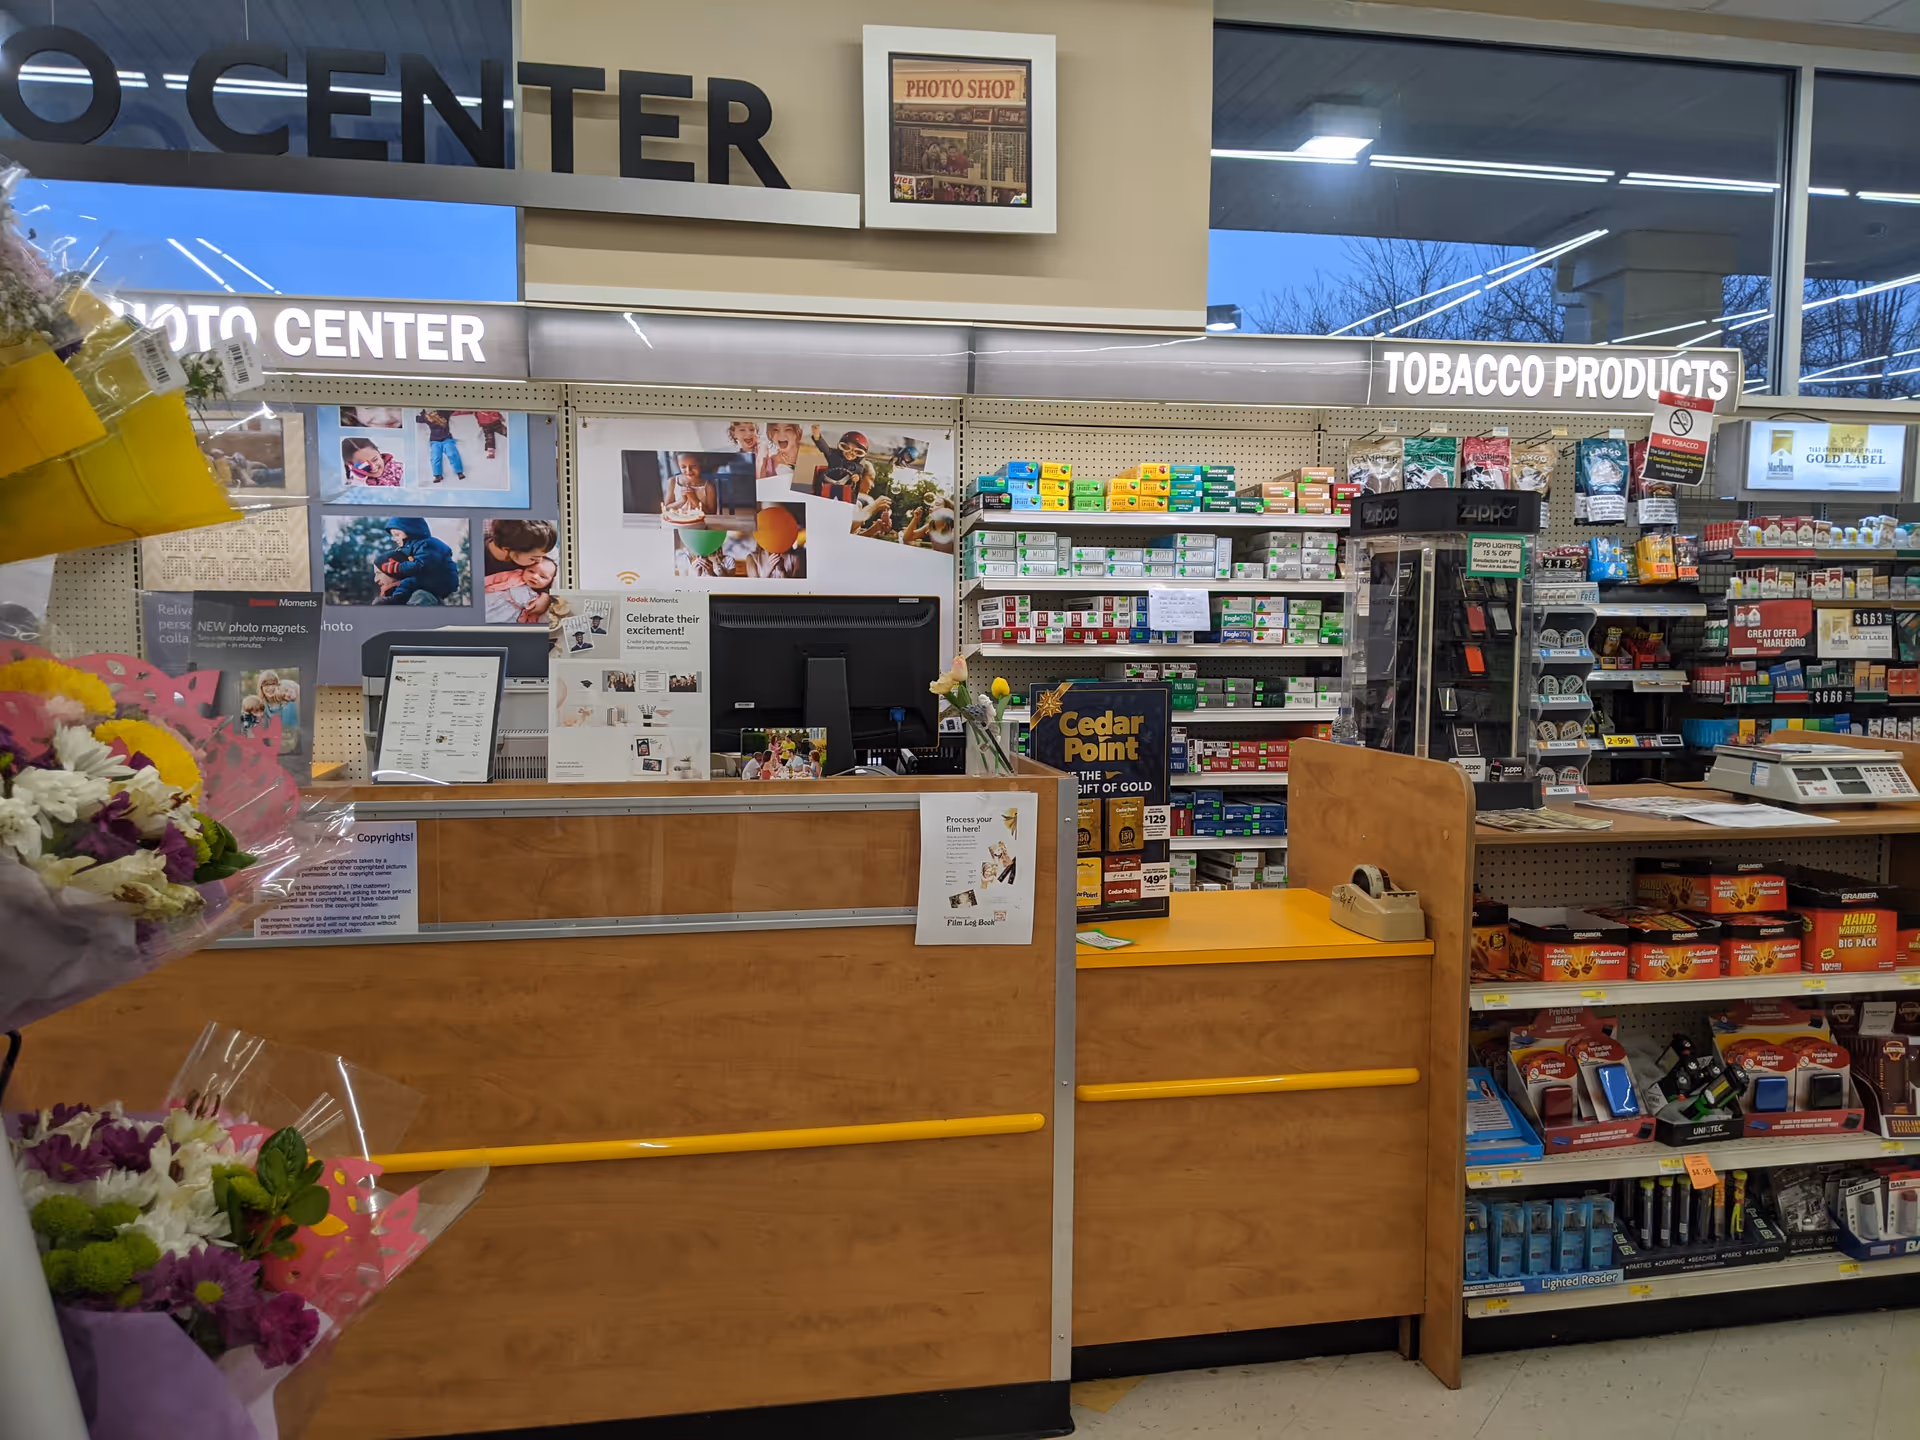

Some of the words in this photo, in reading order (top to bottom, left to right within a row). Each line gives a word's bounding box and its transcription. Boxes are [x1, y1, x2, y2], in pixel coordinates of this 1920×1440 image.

[906, 79, 964, 99] PHOTO
[967, 80, 1015, 99] SHOP
[186, 39, 792, 190] CENTER
[274, 308, 486, 362] CENTER
[1384, 351, 1545, 397] TOBACCO
[1553, 356, 1729, 400] PRODUCTS
[1671, 440, 1699, 449] TOBACCO
[1589, 447, 1622, 457] LARGO
[1672, 458, 1688, 467] Smoking
[1806, 454, 1841, 464] GOLD
[1845, 454, 1886, 465] LABEL
[1768, 458, 1794, 472] Marlboro
[1580, 593, 1596, 601] FREE
[279, 598, 317, 607] Moments
[626, 613, 674, 623] Celebrate
[676, 614, 700, 624] their
[1224, 614, 1240, 622] Eagle
[198, 622, 226, 632] NEW
[229, 622, 259, 634] photo
[261, 623, 309, 635] magnets.
[626, 626, 685, 635] excitement!
[1223, 630, 1240, 638] Eagle
[1747, 629, 1772, 638] GREAT
[1773, 629, 1797, 637] OFFER
[1542, 634, 1559, 643] ROGUE
[1763, 638, 1806, 647] MARLBORO
[1058, 711, 1145, 737] Cedar
[1064, 736, 1139, 762] Point
[1080, 771, 1101, 780] THE
[1077, 783, 1100, 794] GIFT
[1102, 783, 1118, 793] OF
[1120, 782, 1152, 793] GOLD
[946, 816, 975, 824] Process
[976, 816, 992, 825] your
[1145, 814, 1166, 824] $129
[946, 825, 961, 833] film
[962, 825, 981, 833] here!
[357, 832, 414, 844] Copyrights!
[1120, 832, 1133, 841] 150
[964, 919, 977, 927] Log
[1843, 913, 1877, 925] HAND
[1839, 925, 1877, 934] WARMERS
[1838, 938, 1853, 948] BIG
[1856, 937, 1877, 947] PACK
[1590, 949, 1626, 957] Air-Activated
[1821, 963, 1829, 971] 10
[1588, 1045, 1612, 1053] Protective
[1693, 1124, 1723, 1135] UNIQTEC
[1628, 1262, 1652, 1270] PARTIES
[1658, 1258, 1685, 1266] CAMPING
[1691, 1254, 1717, 1262] BEACHES
[1749, 1247, 1763, 1255] BACK
[1541, 1276, 1580, 1291] Lighted
[1581, 1272, 1618, 1284] Reader
